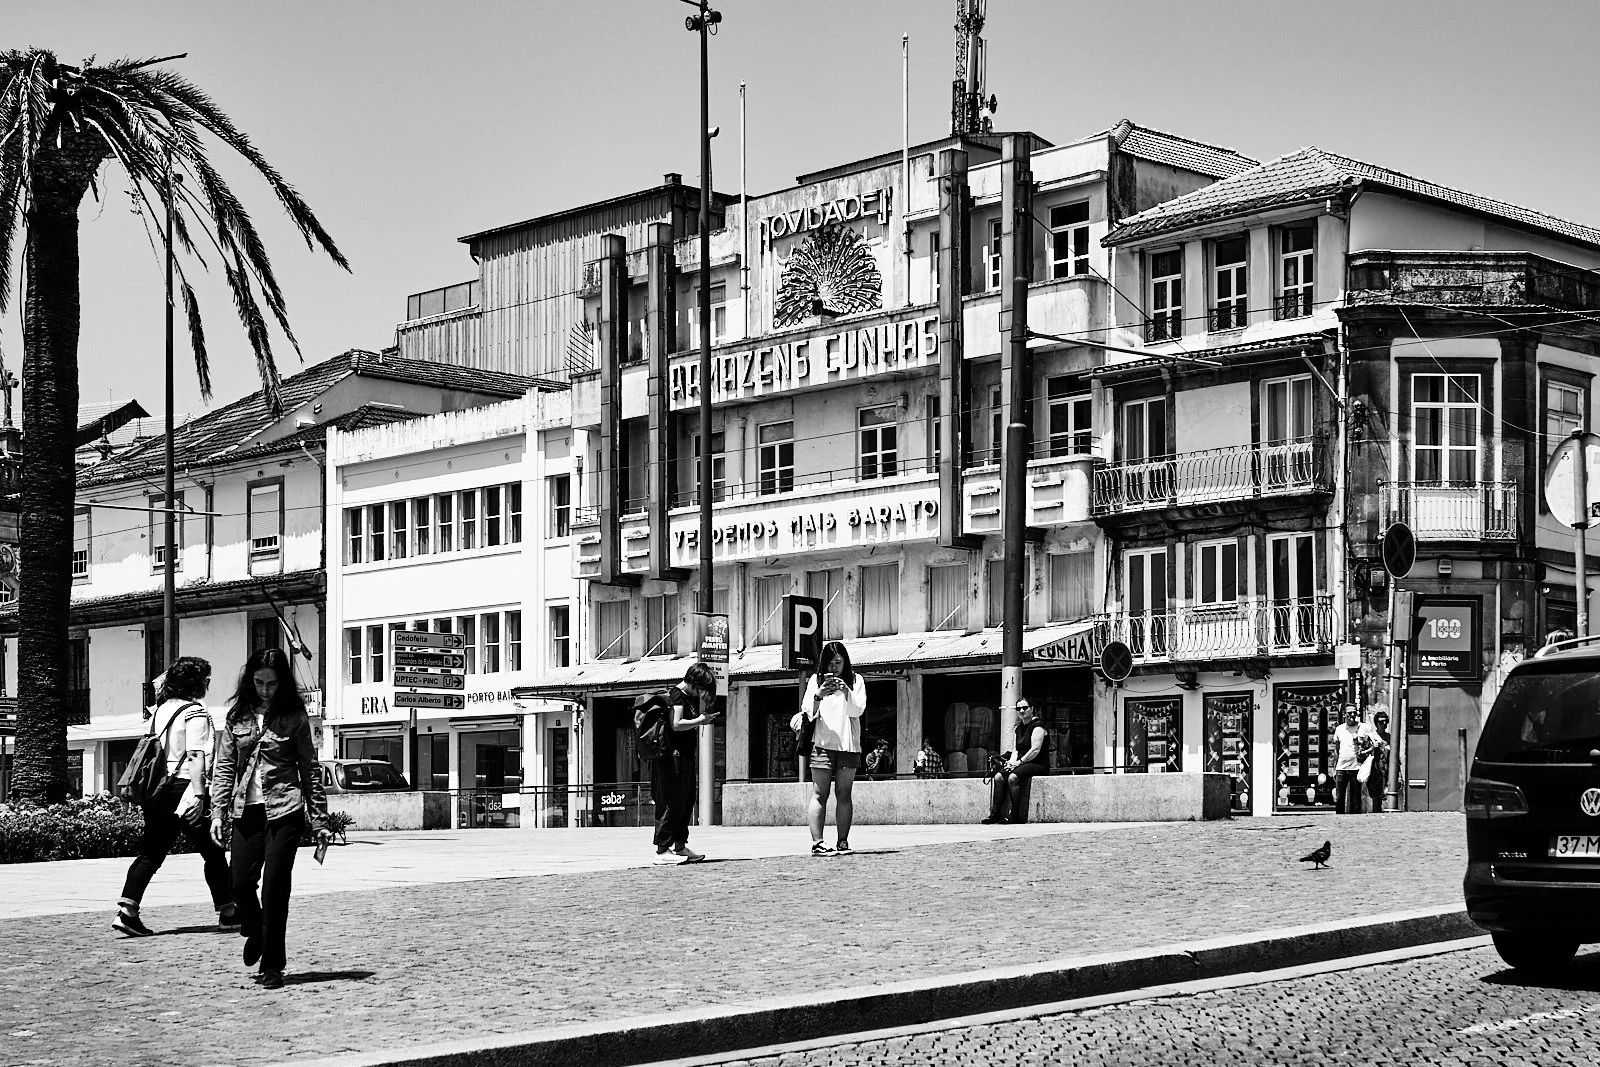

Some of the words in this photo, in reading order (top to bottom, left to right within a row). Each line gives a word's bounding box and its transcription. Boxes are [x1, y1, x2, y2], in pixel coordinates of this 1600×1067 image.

[825, 316, 939, 373] CUNHAS
[674, 519, 778, 549] VEDEMOS
[788, 512, 836, 534] MAIS
[847, 498, 938, 527] BARATO
[794, 604, 818, 652] P
[397, 635, 428, 643] Cedofeita
[423, 677, 439, 685] PINC
[361, 696, 388, 714] ERA
[467, 692, 494, 704] PORTO
[397, 695, 416, 703] Carlos
[418, 696, 442, 704] Alberto
[601, 792, 622, 805] saba
